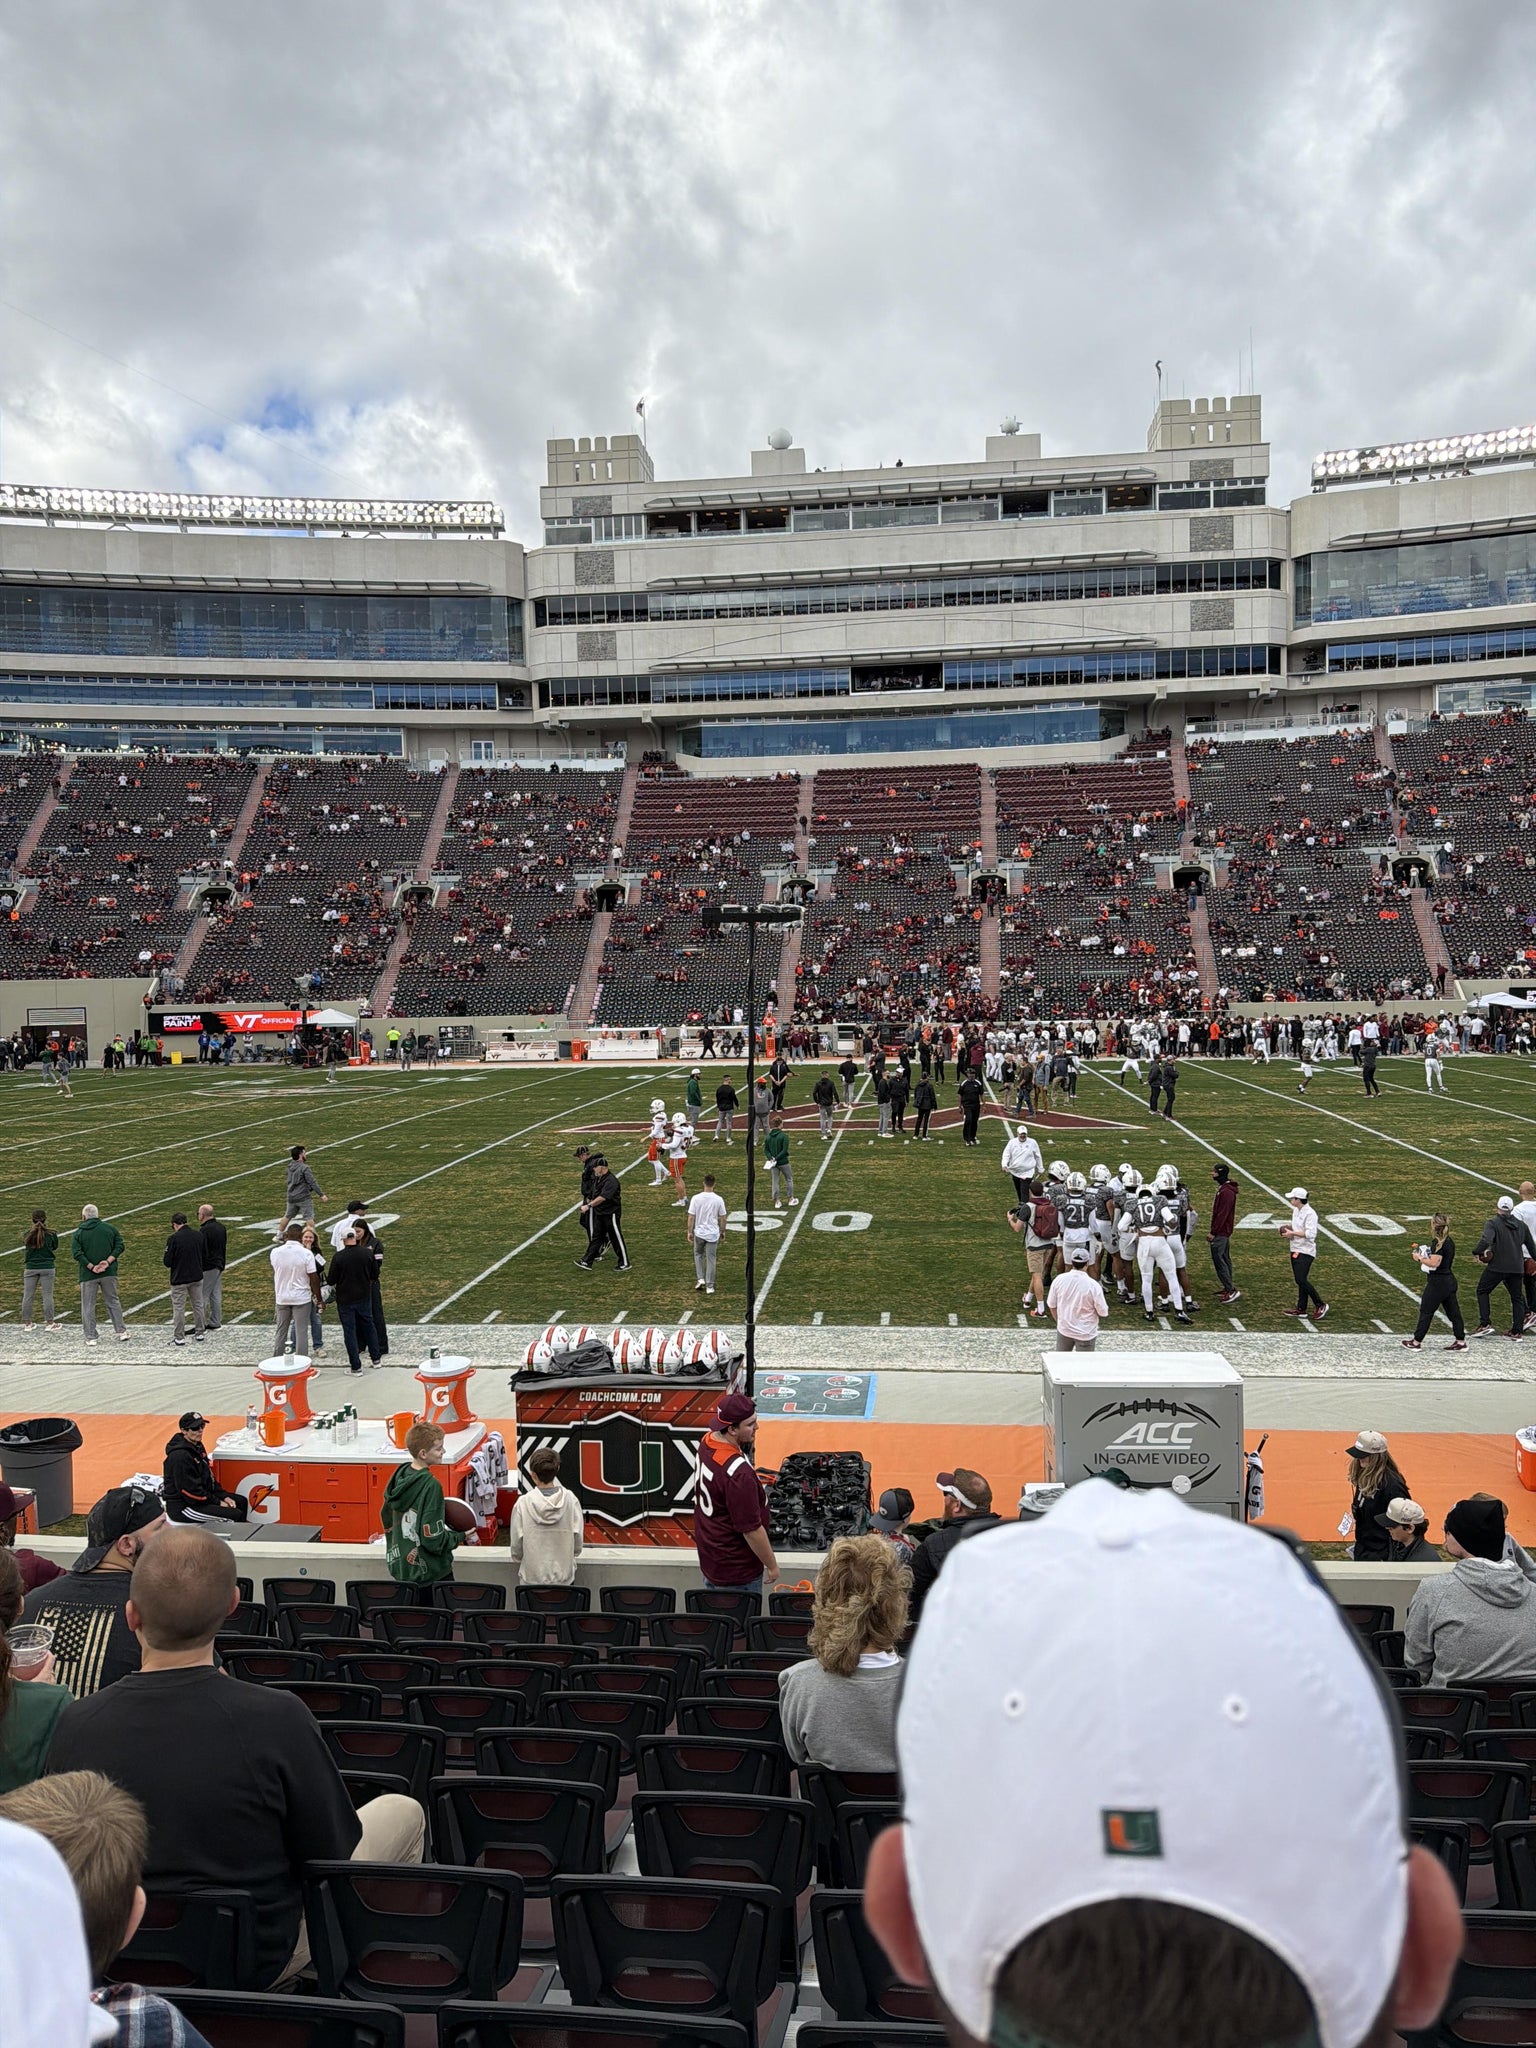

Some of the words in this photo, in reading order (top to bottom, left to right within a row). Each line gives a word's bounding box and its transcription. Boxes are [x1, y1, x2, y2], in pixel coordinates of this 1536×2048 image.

[163, 1020, 193, 1028] PAINT
[233, 1014, 263, 1028] VT
[1066, 1205, 1085, 1222] 21
[1138, 1203, 1156, 1222] 19
[269, 1385, 287, 1405] G
[432, 1386, 450, 1407] G
[579, 1391, 662, 1403] COACHCOMM.COM
[1112, 1422, 1198, 1444] ACC
[579, 1440, 664, 1494] U
[1094, 1453, 1159, 1465] IN-GAME
[1165, 1453, 1210, 1465] VIDEO
[235, 1473, 280, 1524] G
[423, 1519, 444, 1537] U
[1107, 1814, 1153, 1851] U
